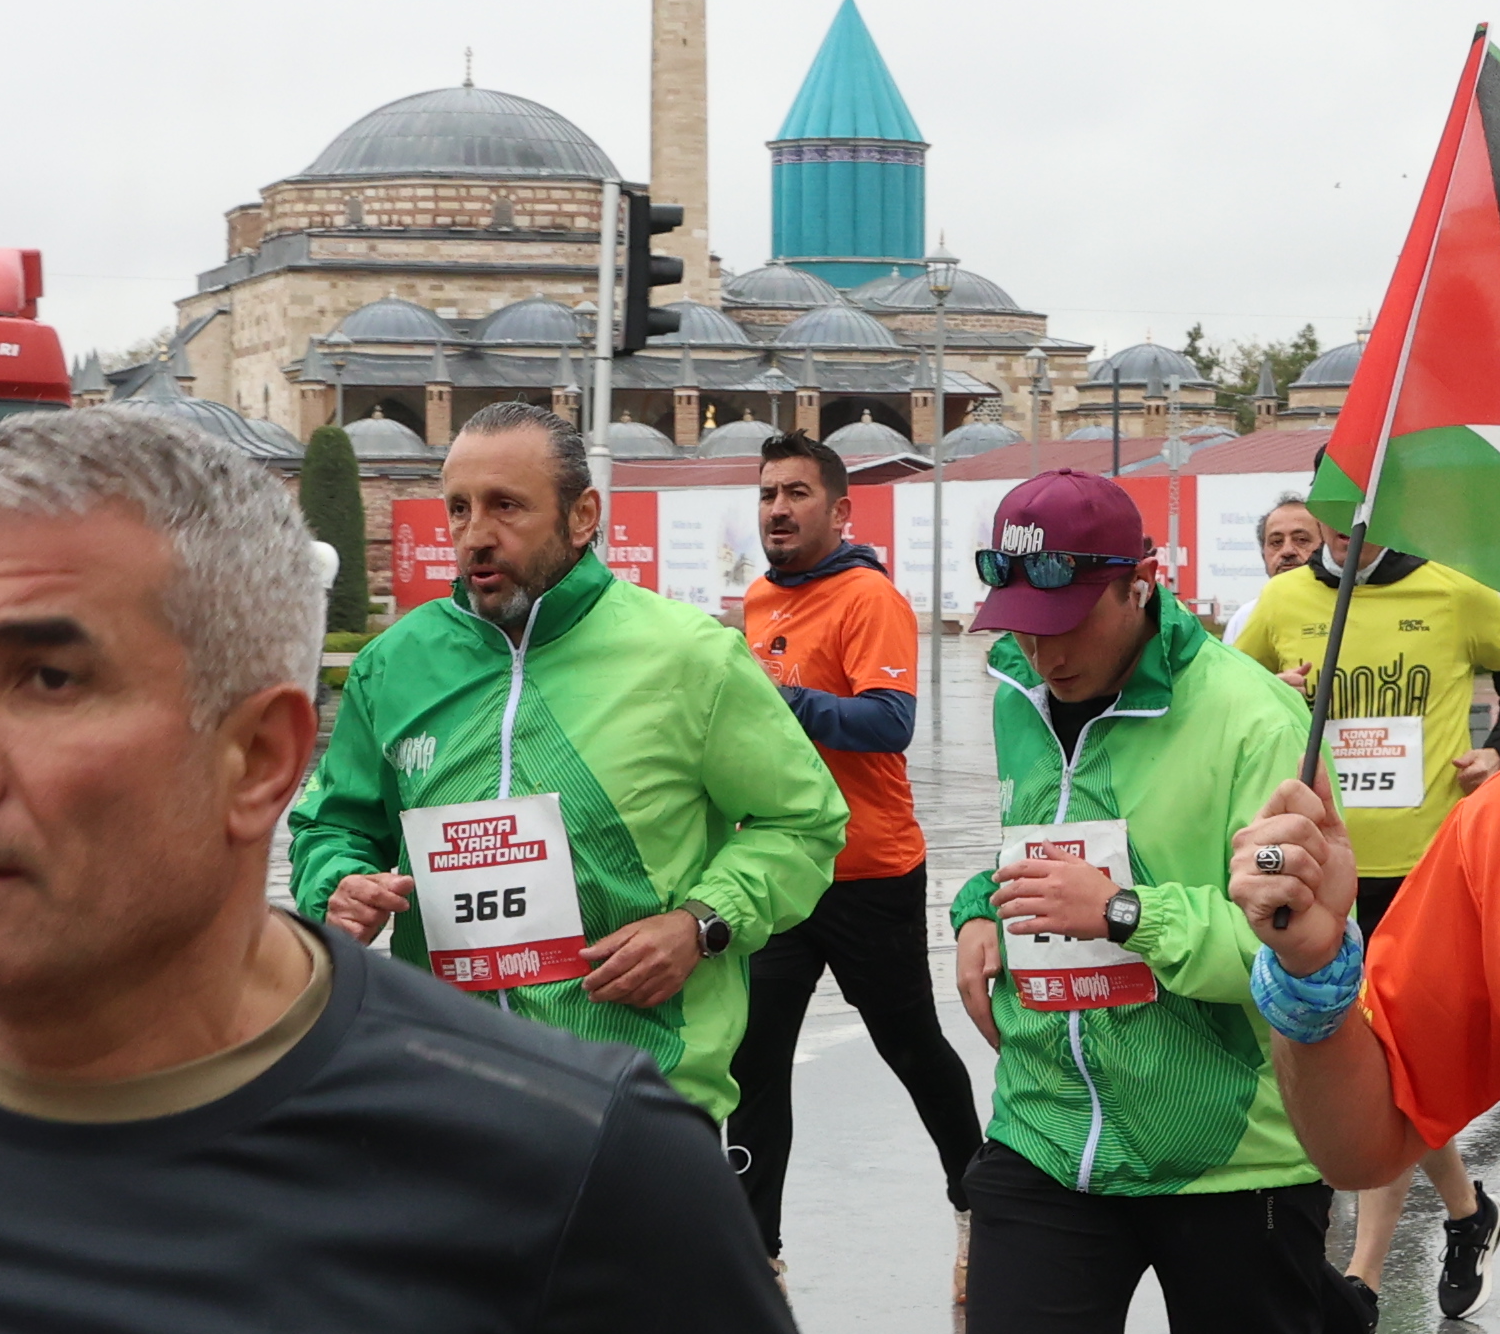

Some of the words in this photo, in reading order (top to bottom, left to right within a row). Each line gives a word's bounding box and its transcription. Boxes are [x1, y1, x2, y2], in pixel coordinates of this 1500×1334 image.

[1341, 730, 1386, 741] KONYA
[1348, 739, 1378, 748] YARI
[1337, 772, 1396, 790] 2155
[447, 818, 511, 840] KONYA
[456, 835, 501, 852] YARI
[433, 844, 540, 869] MARATONU
[454, 886, 526, 924] 366
